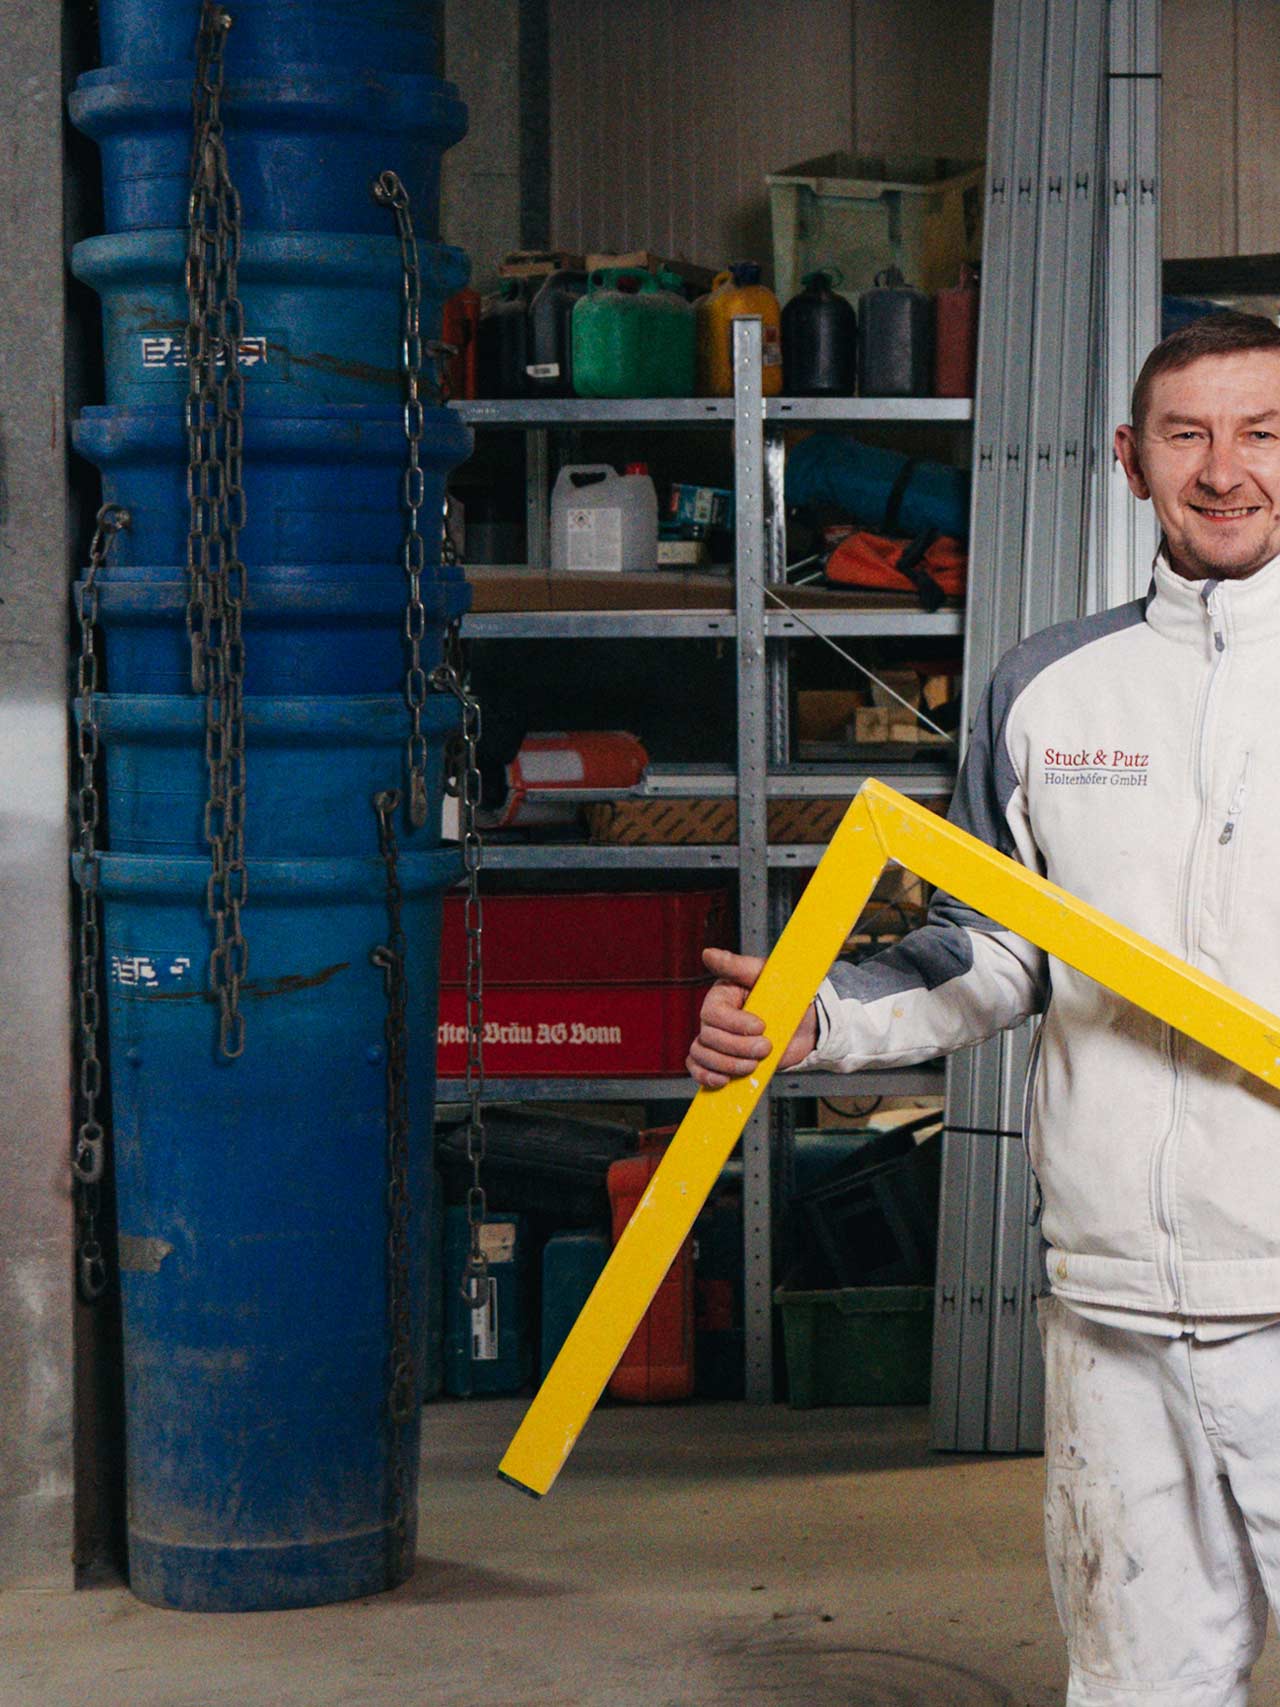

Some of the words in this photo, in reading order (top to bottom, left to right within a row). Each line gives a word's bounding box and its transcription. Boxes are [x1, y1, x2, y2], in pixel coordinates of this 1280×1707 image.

[1044, 748, 1090, 766] Stuck
[1093, 749, 1107, 766] &
[1112, 750, 1149, 767] Putz
[1110, 774, 1148, 786] GmbH
[536, 1022, 568, 1044] AG
[569, 1022, 621, 1044] Bonn
